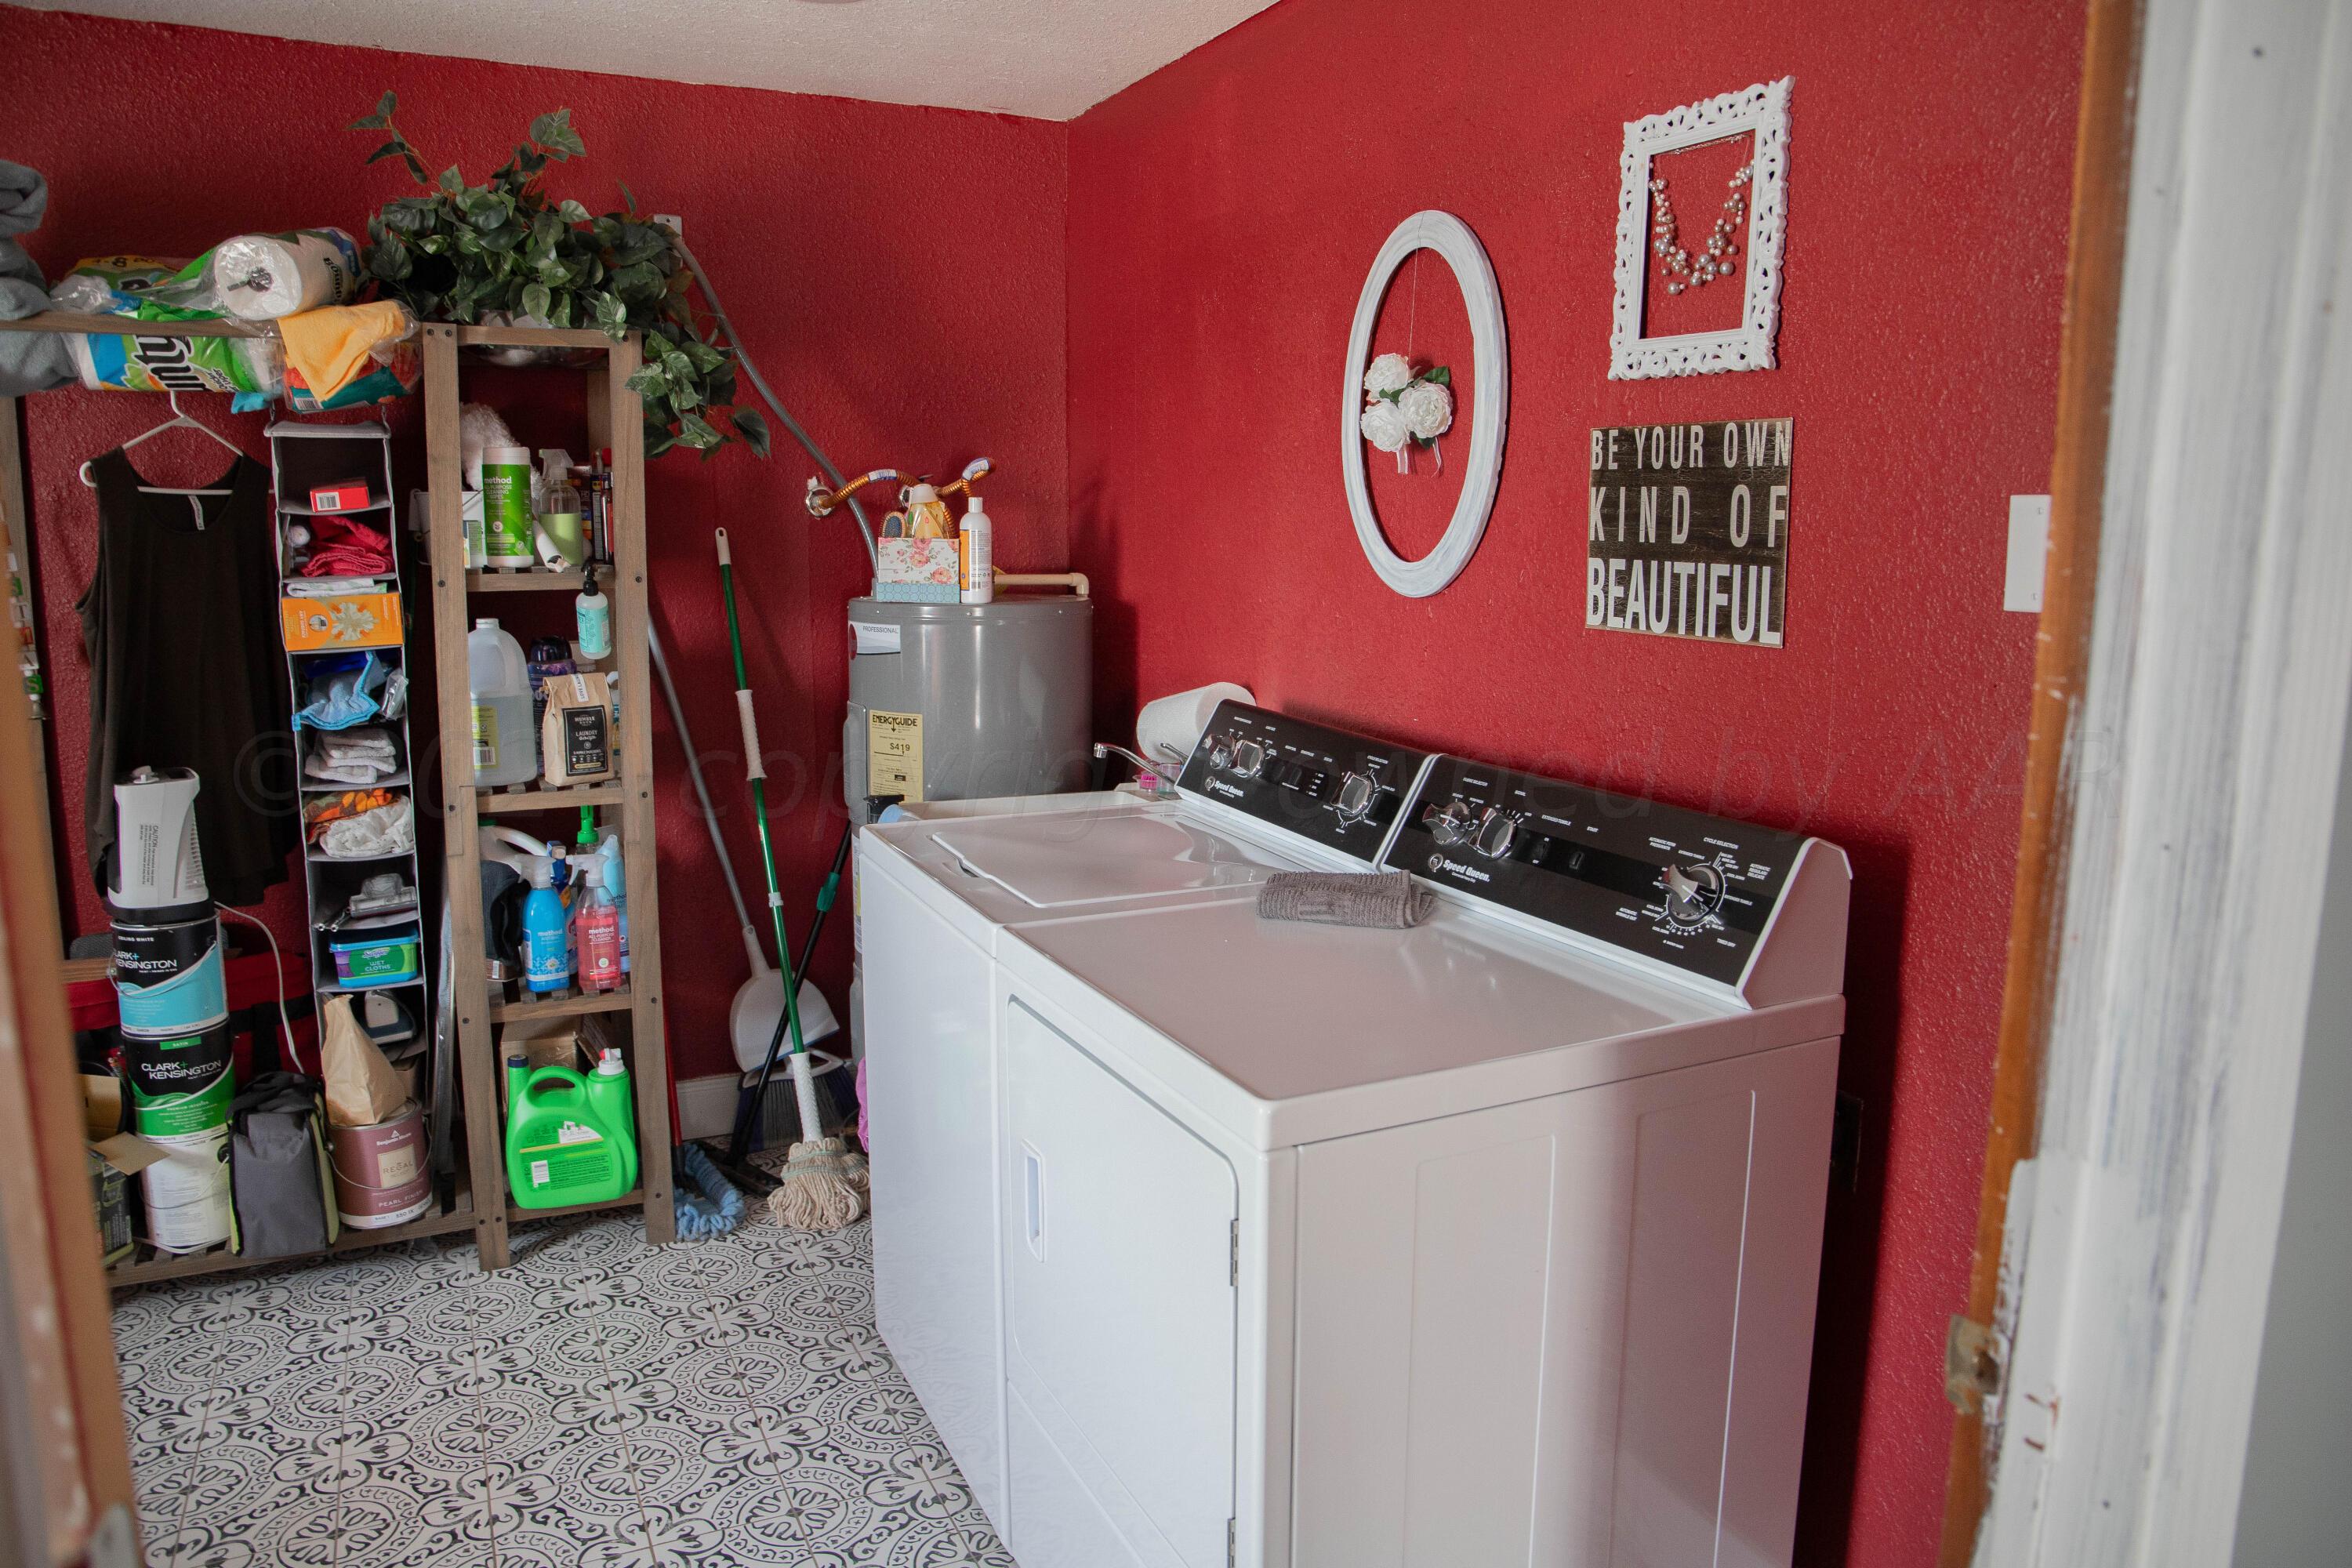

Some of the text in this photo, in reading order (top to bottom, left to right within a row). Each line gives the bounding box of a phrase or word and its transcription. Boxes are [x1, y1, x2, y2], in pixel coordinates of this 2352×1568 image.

[1592, 420, 1791, 470] BE YOUR OWN
[1589, 485, 1788, 547] KIND OF
[1587, 557, 1780, 644] BEAUTIFUL
[863, 625, 898, 634] PROFESSIONAL
[872, 714, 918, 728] ENERGYGUIDE
[1214, 779, 1230, 791] Speed
[1443, 858, 1489, 882] Speed Queen
[588, 926, 615, 935] method
[115, 959, 178, 969] ENSINGTON
[149, 1059, 222, 1080] KENSINGTON
[383, 1160, 414, 1174] REGAL
[378, 1198, 402, 1208] PEARL
